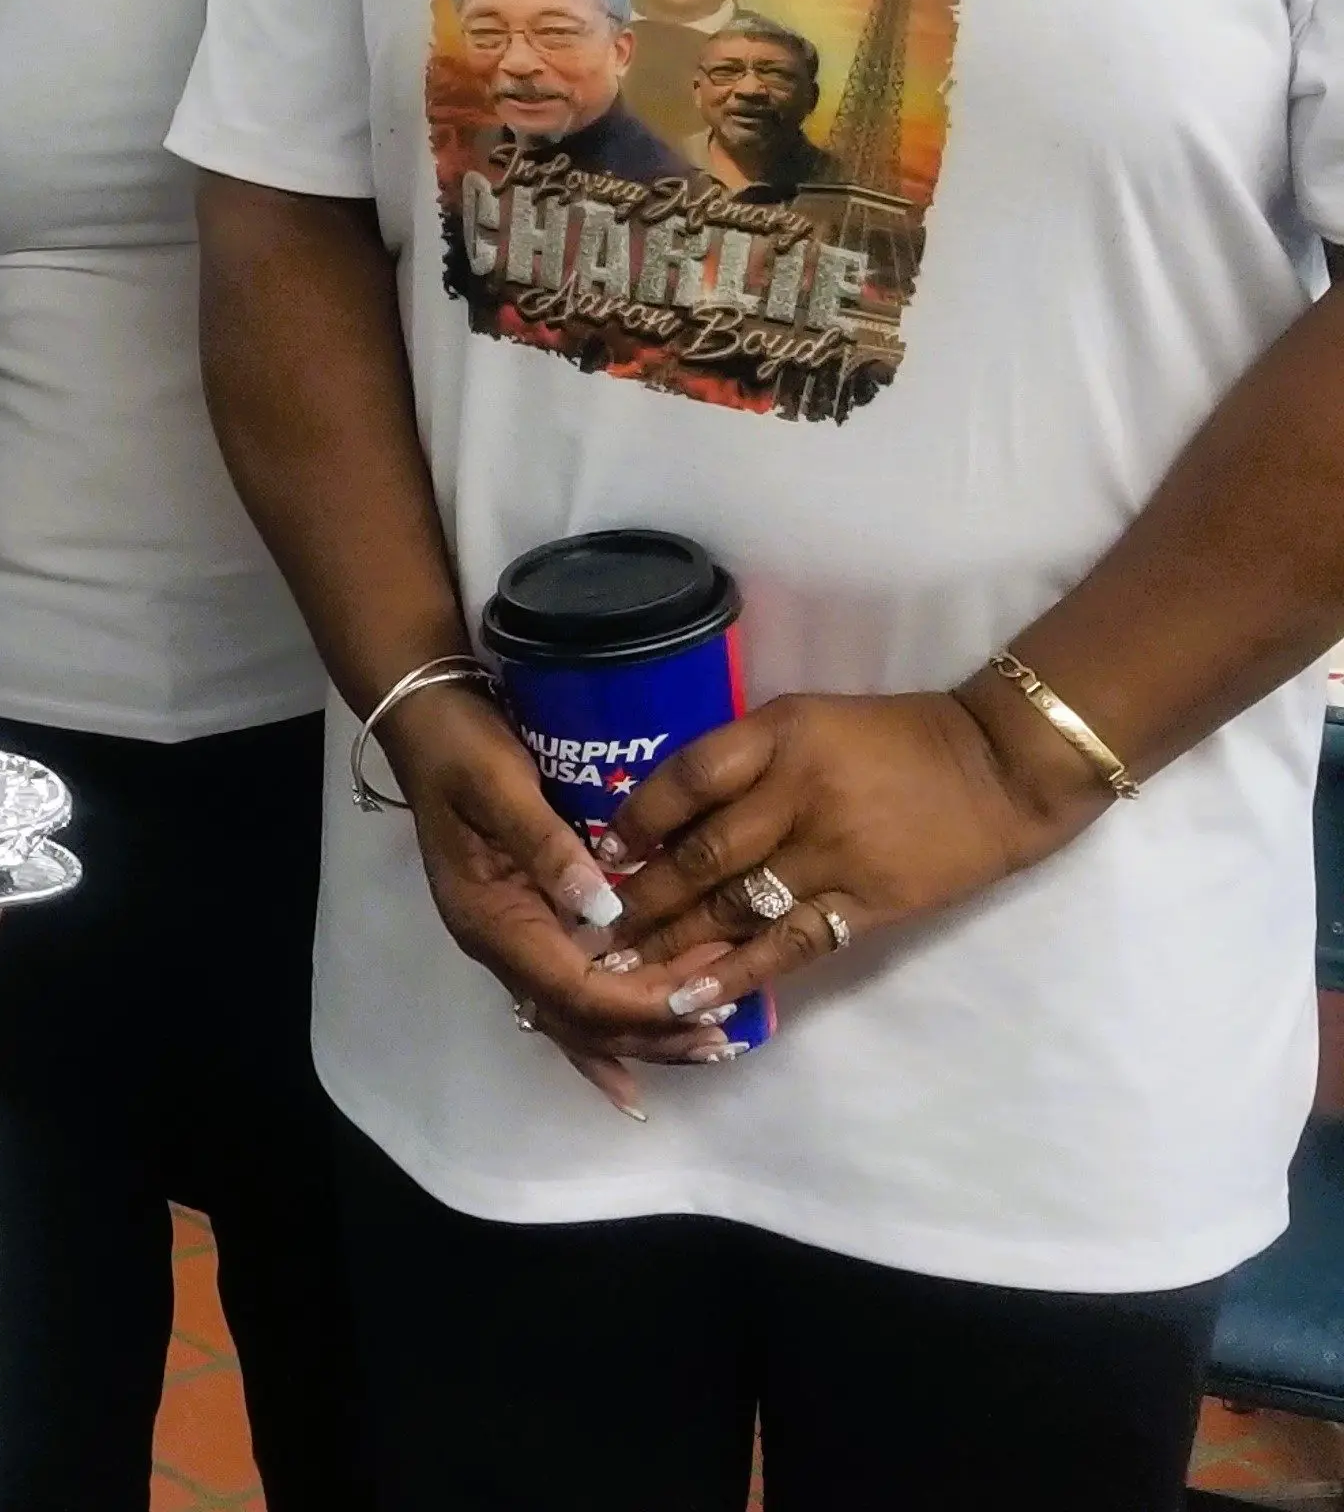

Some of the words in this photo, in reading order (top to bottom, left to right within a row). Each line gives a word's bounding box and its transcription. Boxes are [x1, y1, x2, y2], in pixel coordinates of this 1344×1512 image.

[488, 144, 535, 191] In
[532, 152, 648, 223] Loving
[642, 176, 815, 250] Memory
[461, 170, 870, 334] CHARLIE
[682, 304, 854, 379] Boyd
[521, 724, 669, 764] MURPHY
[539, 755, 603, 787] USA
